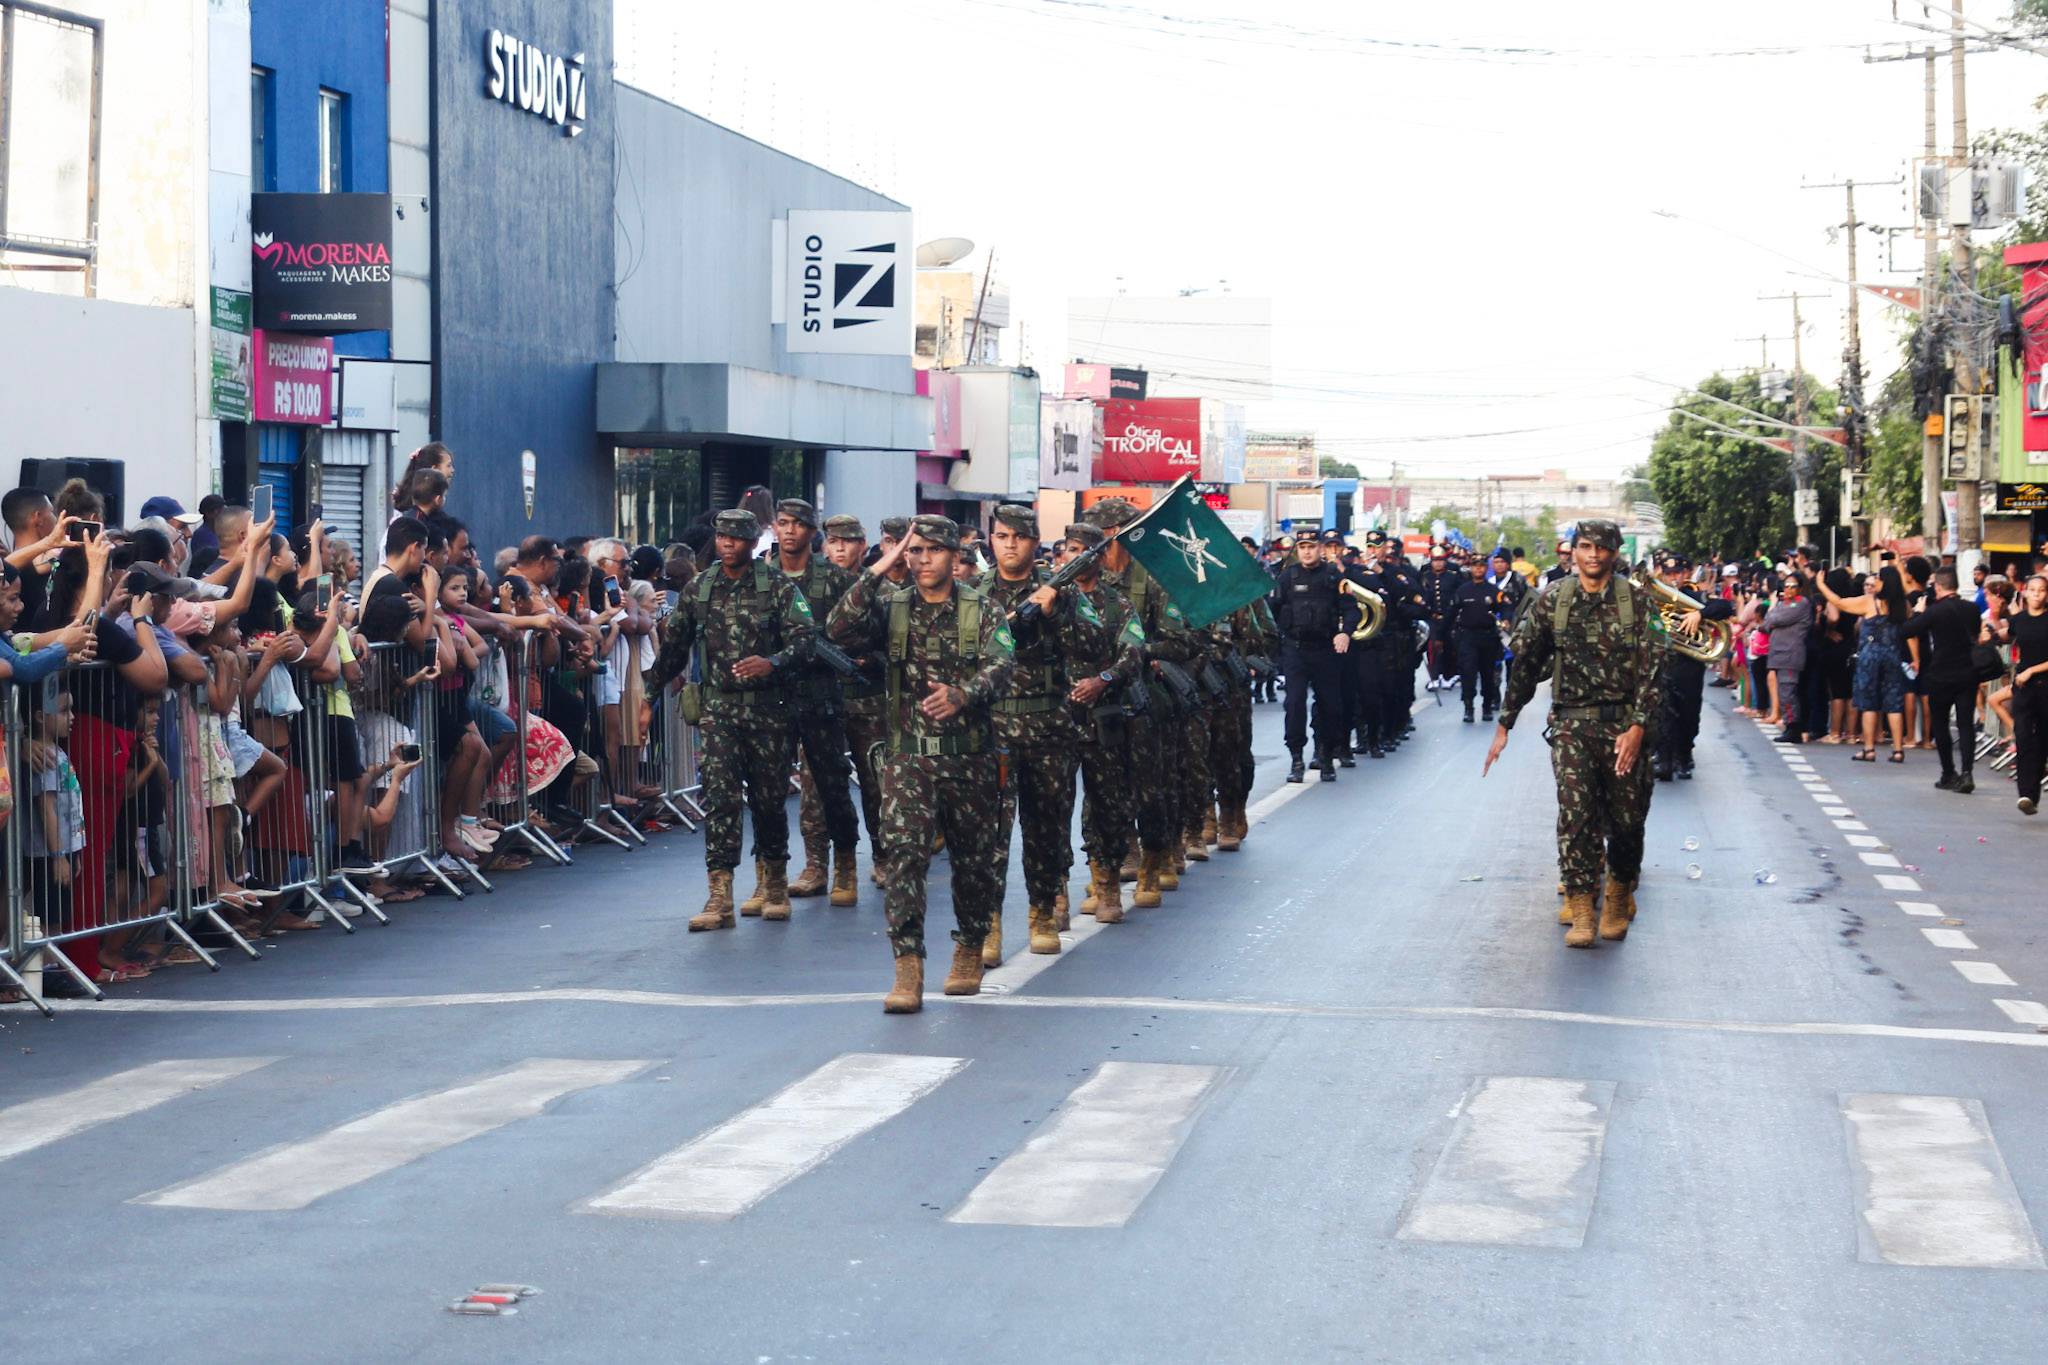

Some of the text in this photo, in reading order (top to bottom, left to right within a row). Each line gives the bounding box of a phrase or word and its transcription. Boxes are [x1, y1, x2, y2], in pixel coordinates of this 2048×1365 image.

[490, 29, 567, 125] STUDIO
[284, 242, 390, 269] MORENA
[330, 264, 391, 285] MAKES
[803, 234, 896, 333] STUDIO Z
[274, 379, 292, 417] R$
[1125, 422, 1162, 438] Ótica
[1104, 436, 1198, 459] TROPICAL
